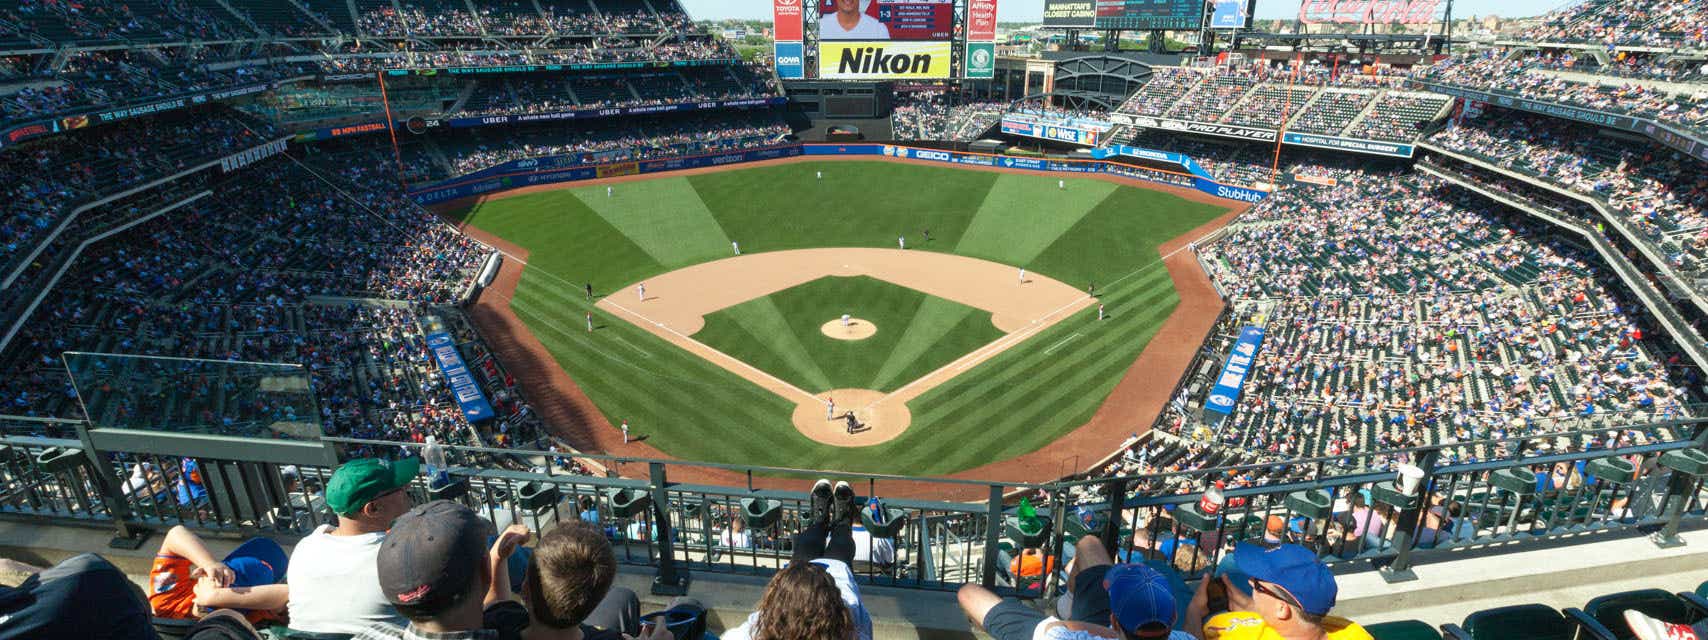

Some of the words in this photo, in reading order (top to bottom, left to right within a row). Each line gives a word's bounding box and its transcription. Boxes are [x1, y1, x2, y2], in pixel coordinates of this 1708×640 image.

[972, 3, 995, 11] Affinity
[838, 47, 931, 74] Nikon
[99, 112, 112, 121] THE
[114, 110, 128, 118] WAY
[482, 116, 508, 124] UBER
[356, 124, 386, 132] FASTBALL
[1186, 123, 1216, 133] PRO
[1216, 124, 1274, 139] PLAYER
[1057, 127, 1077, 141] WISE
[1302, 137, 1328, 145] HOSPITAL
[1340, 140, 1366, 149] SPECIAL
[916, 150, 949, 161] GEICO
[1140, 150, 1168, 160] HONDA
[1218, 186, 1262, 203] StubHub
